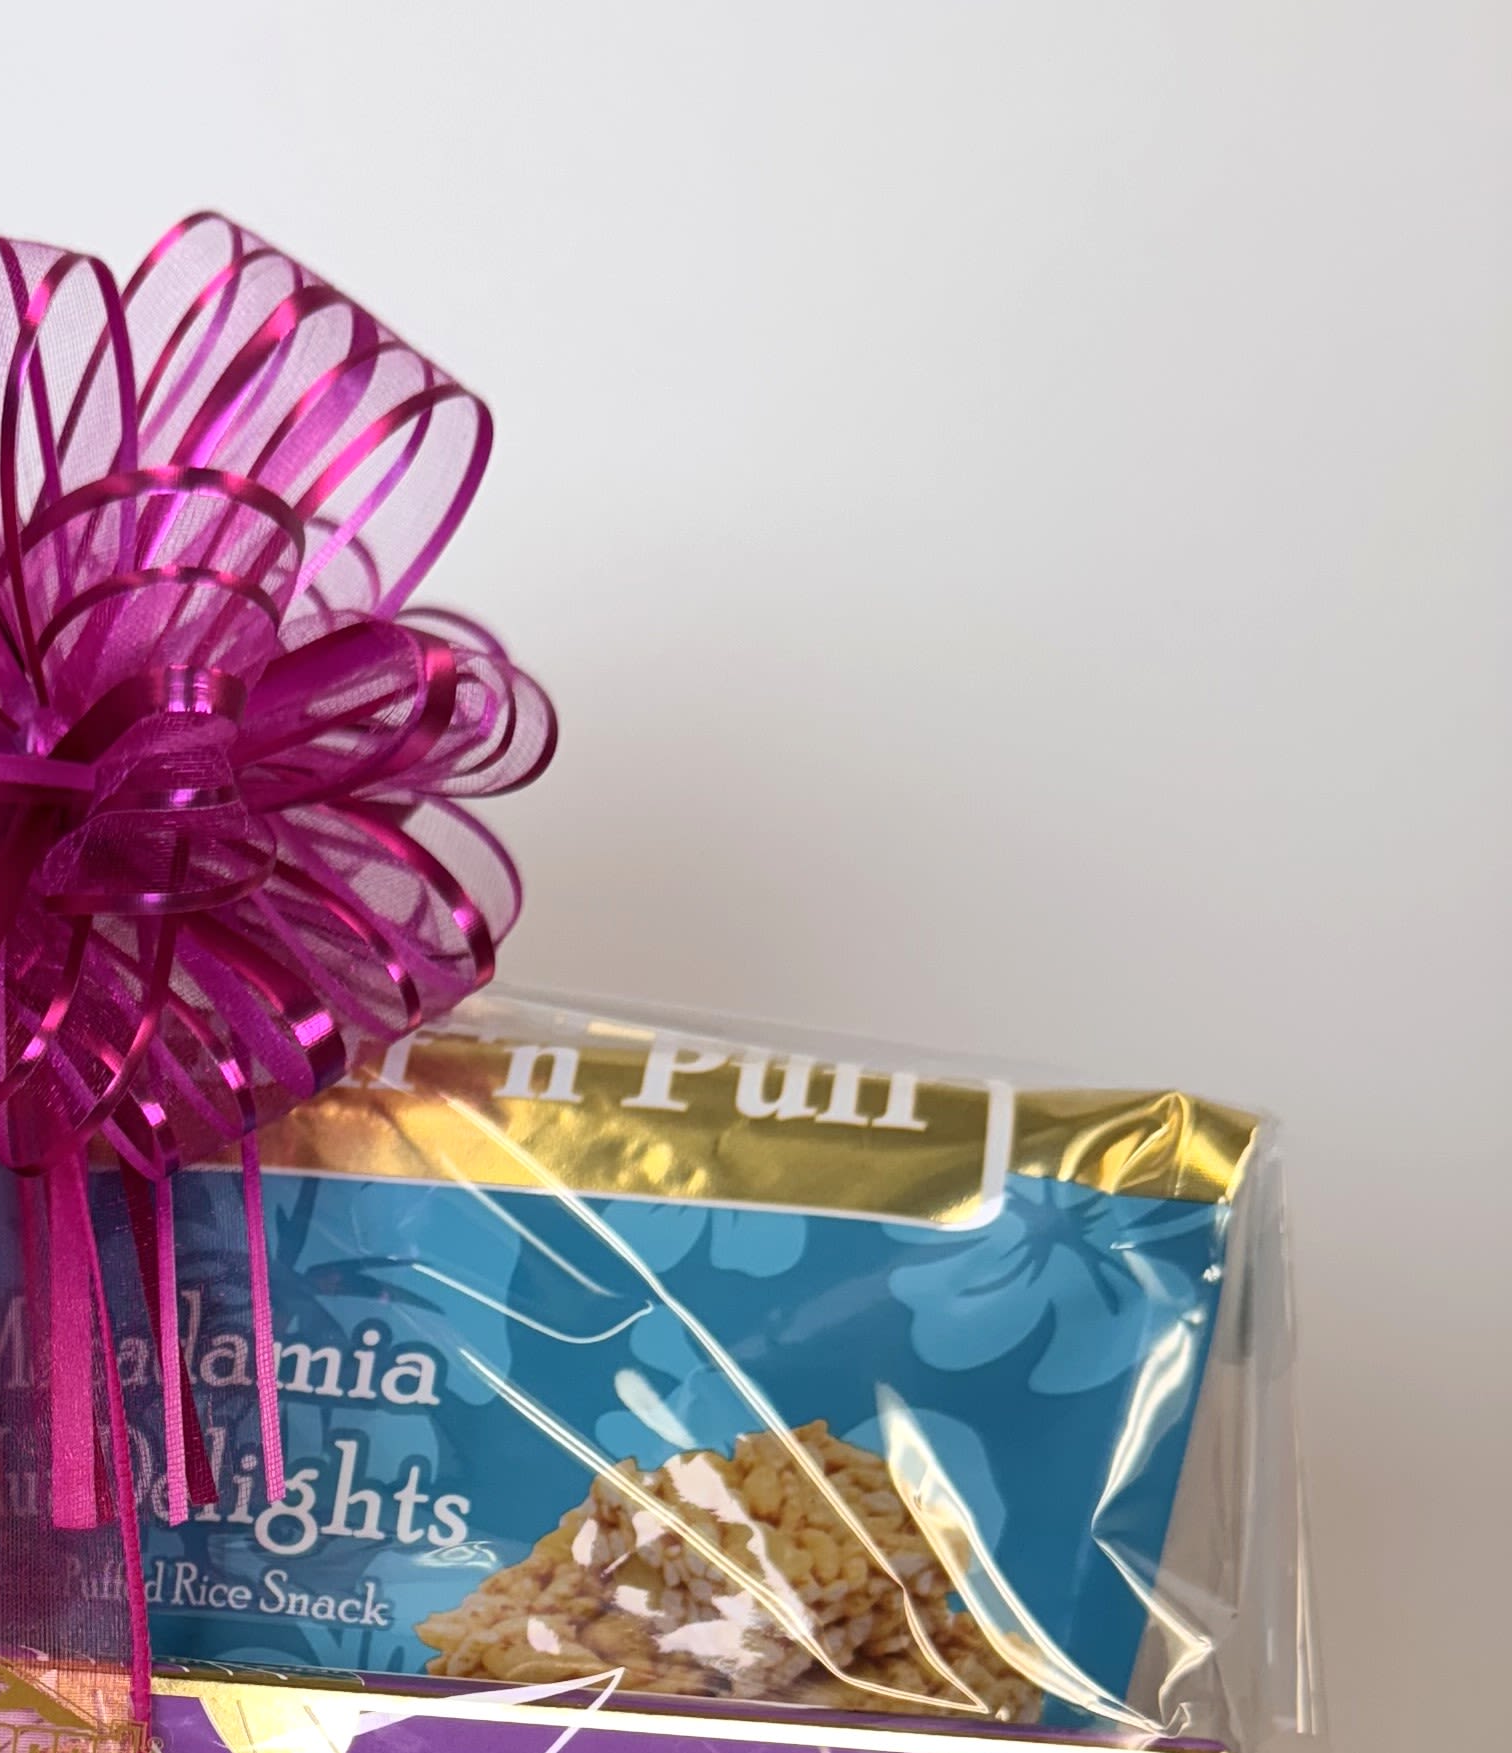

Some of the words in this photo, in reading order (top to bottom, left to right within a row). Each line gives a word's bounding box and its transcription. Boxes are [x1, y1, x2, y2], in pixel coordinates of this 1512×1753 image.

[64, 1553, 163, 1605] Puffd
[173, 1561, 253, 1612] Rice
[259, 1569, 389, 1627] Snack
